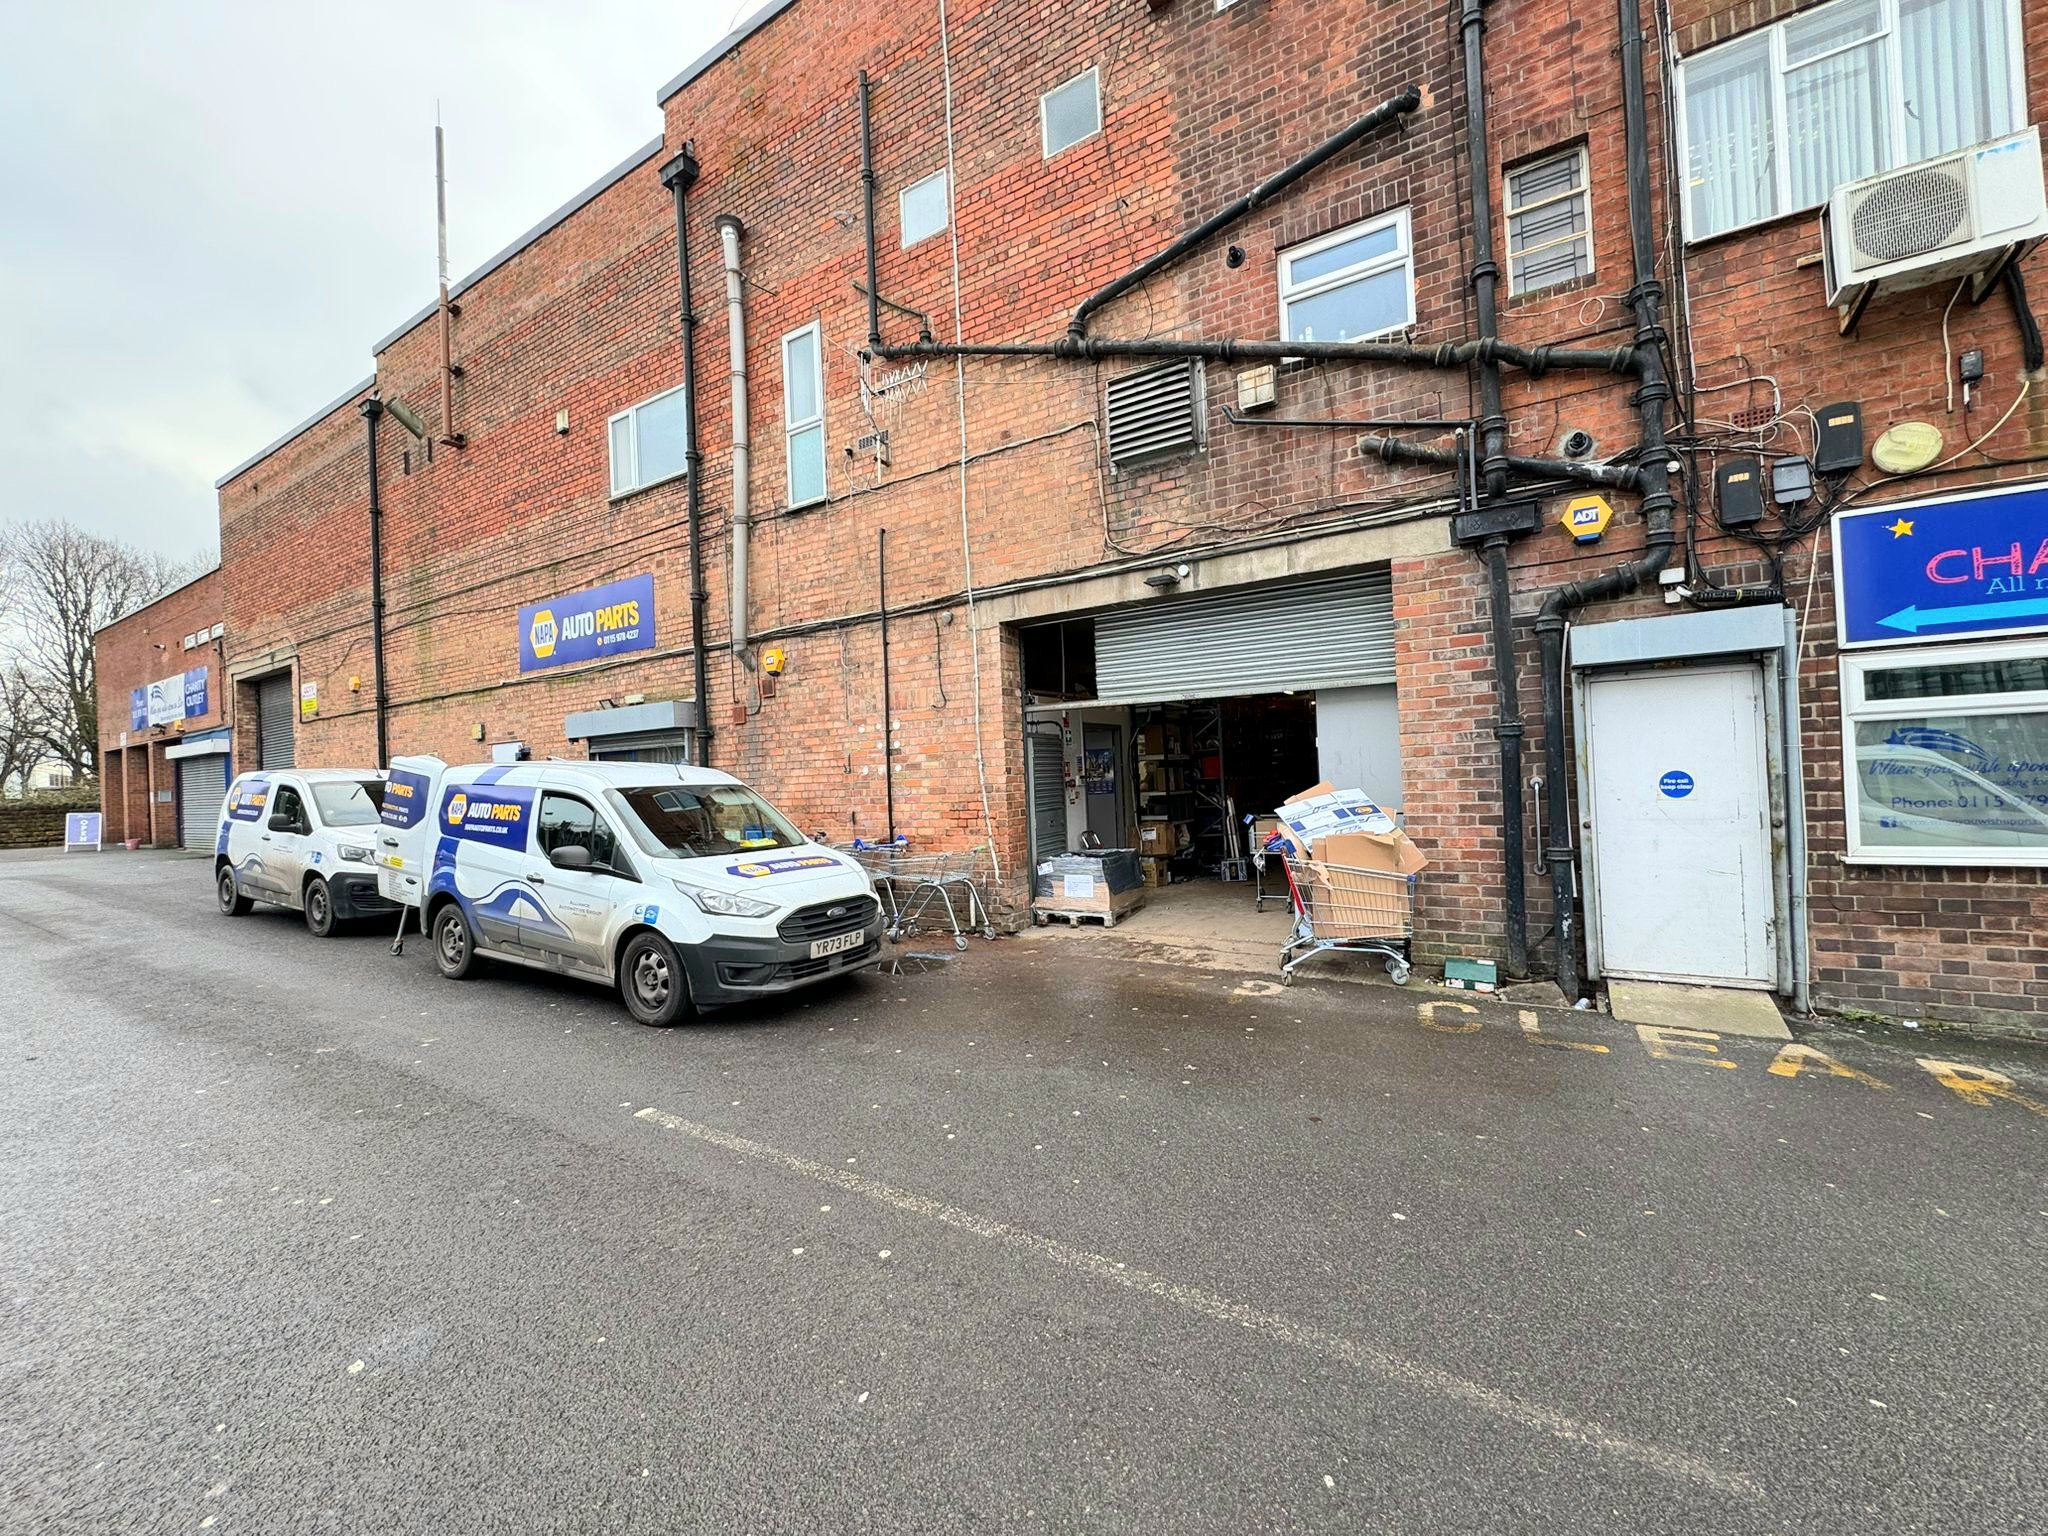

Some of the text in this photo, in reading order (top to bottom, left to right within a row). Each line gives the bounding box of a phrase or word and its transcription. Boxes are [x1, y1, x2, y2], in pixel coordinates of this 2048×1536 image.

[1574, 508, 1598, 523] ADT
[1926, 538, 2048, 584] CHA
[1985, 576, 2026, 594] All
[534, 600, 640, 646] NAPA AUTO PARTS
[1869, 759, 1914, 776] When
[2007, 759, 2048, 777] upon
[391, 782, 414, 798] PARTS
[1891, 795, 1953, 809] Phone:
[1957, 794, 2005, 809] 0115
[467, 802, 493, 819] AUTO
[490, 803, 522, 822] PARTS
[815, 931, 862, 955] YR73 FLP
[1416, 1000, 2048, 1116] CLEAR
